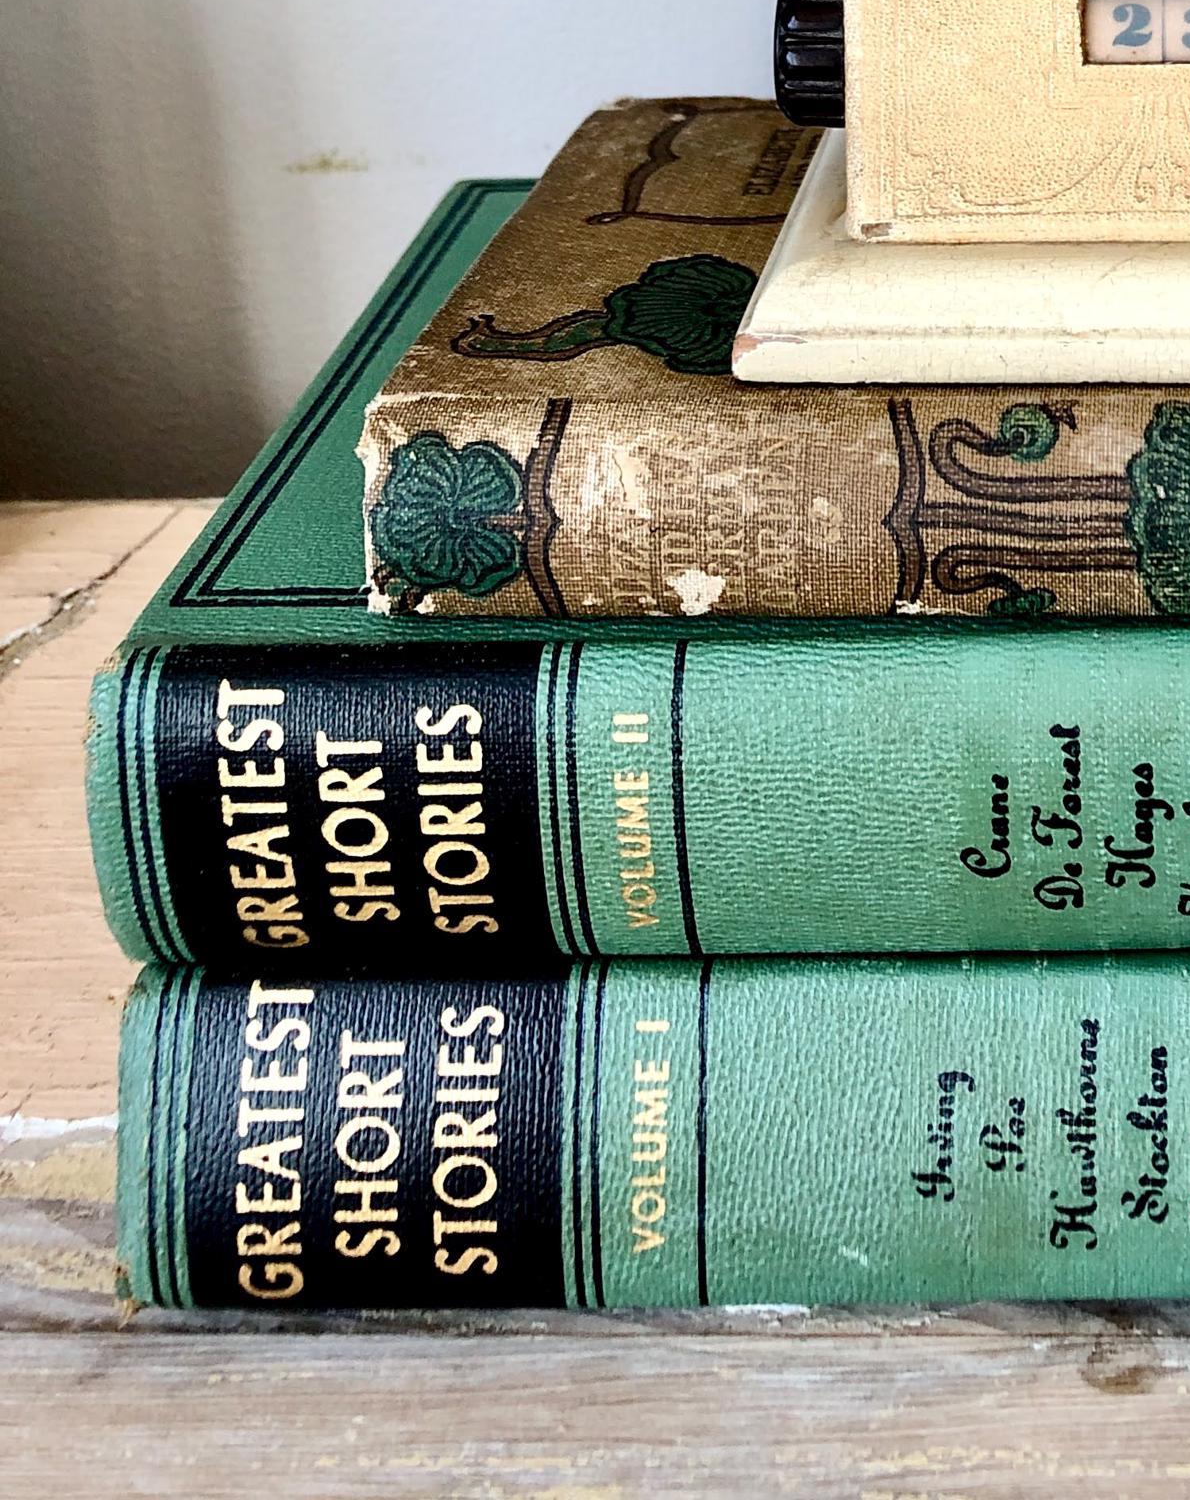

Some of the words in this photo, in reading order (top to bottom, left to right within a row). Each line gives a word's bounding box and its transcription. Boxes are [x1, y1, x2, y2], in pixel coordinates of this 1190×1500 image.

[217, 678, 310, 949] GREATEST
[415, 702, 500, 935] STORIES
[612, 712, 650, 744] II
[1030, 723, 1084, 850] Forest
[316, 730, 401, 922] SHORT
[612, 770, 659, 931] VOLUME
[960, 773, 1012, 879] Crane
[1033, 861, 1085, 911] De
[235, 978, 315, 1301] GREATEST
[334, 1028, 406, 1257] SHORT
[432, 1003, 505, 1275] STORIES
[631, 1066, 671, 1256] VOLUME
[910, 1070, 976, 1202] Irving
[979, 1097, 1026, 1173] Poe
[1049, 1018, 1101, 1250] Hawthorne
[1120, 1045, 1169, 1224] Stockton
